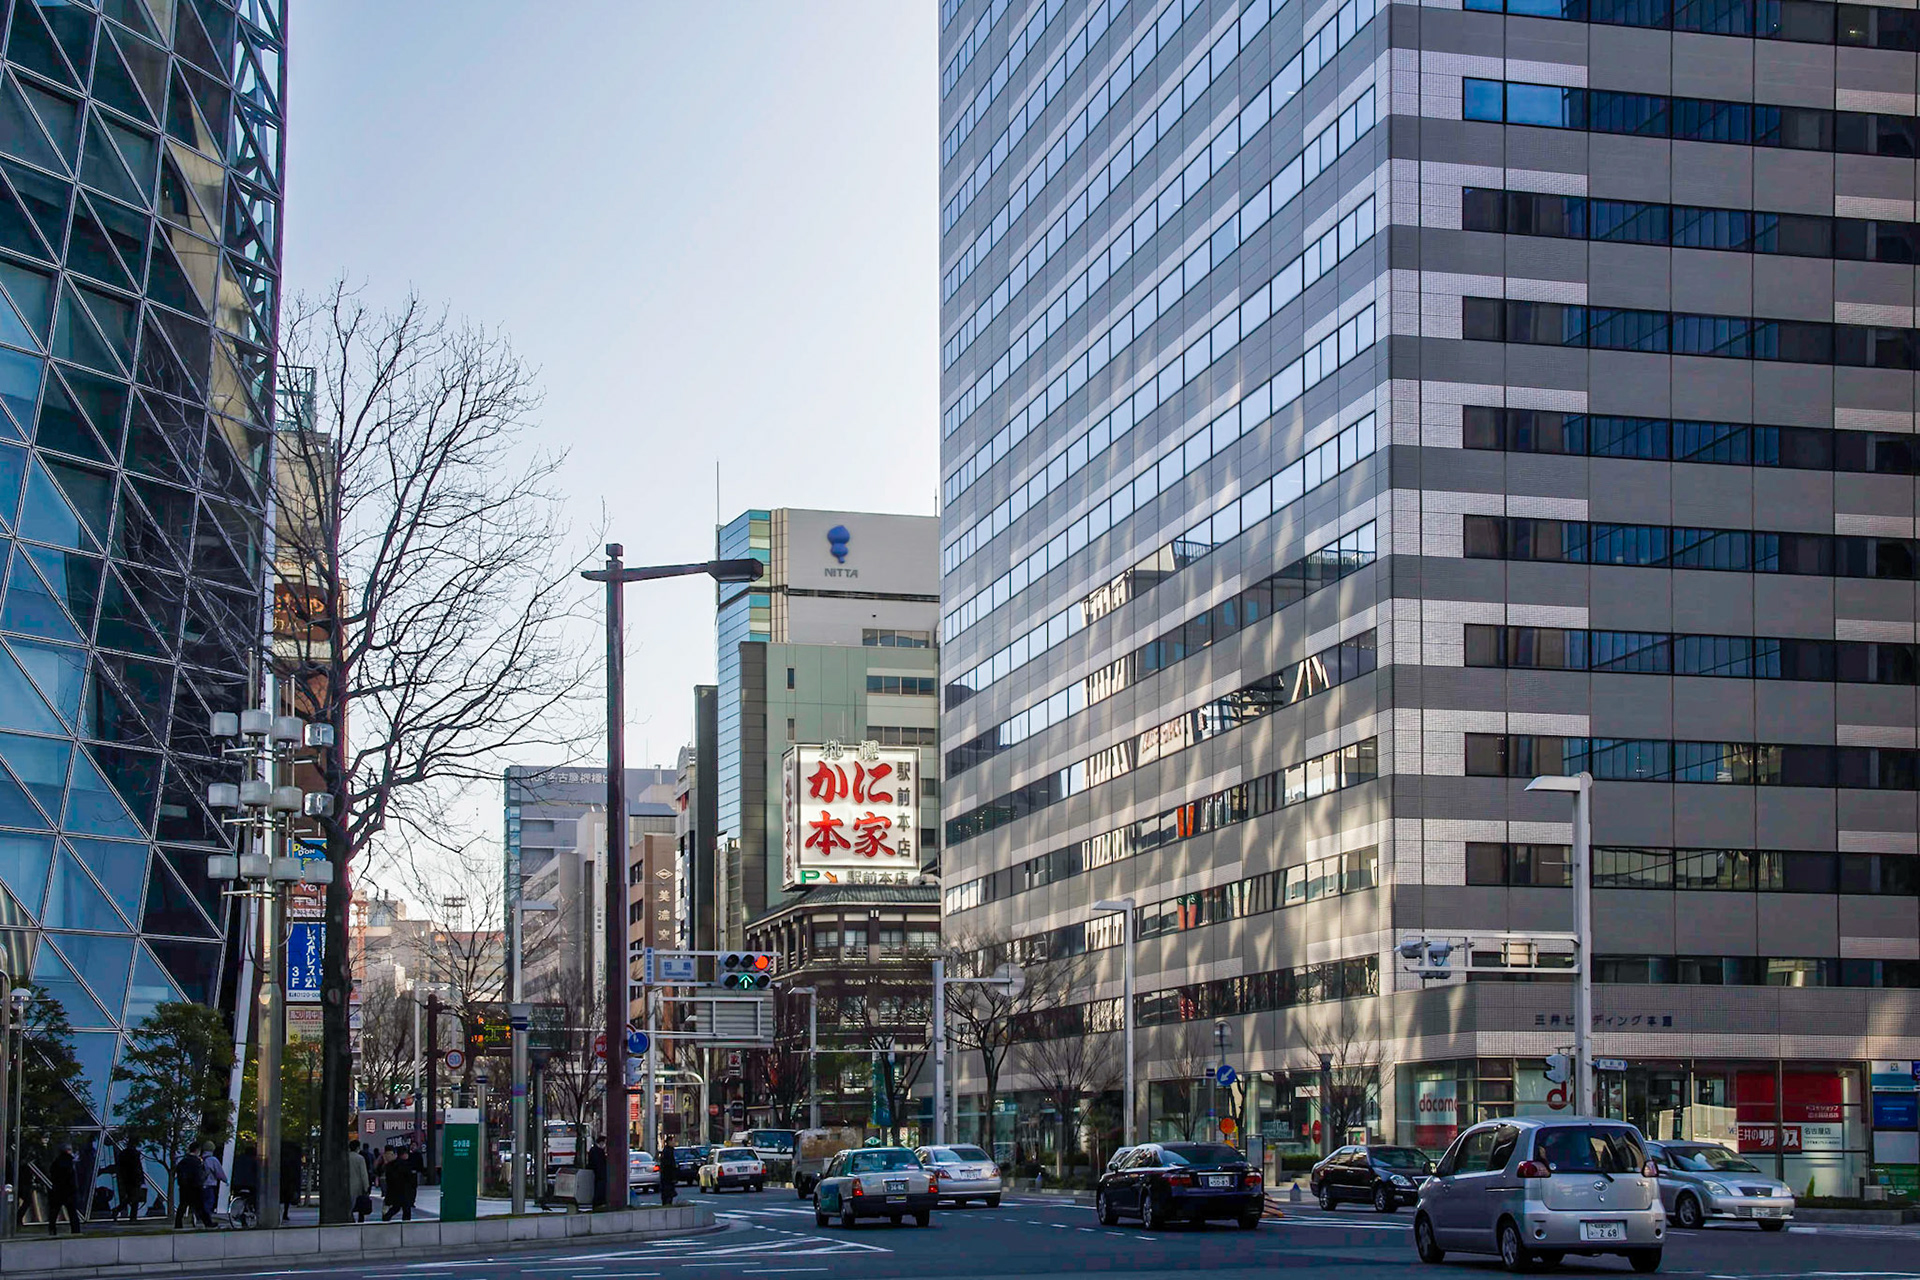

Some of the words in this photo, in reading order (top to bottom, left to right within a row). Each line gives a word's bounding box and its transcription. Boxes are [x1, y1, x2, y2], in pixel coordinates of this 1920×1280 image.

[825, 568, 858, 578] NITTA
[806, 760, 893, 804] かに
[897, 761, 911, 858] 駅前本店
[805, 810, 896, 858] 本家
[846, 870, 910, 885] 駅前本店
[1535, 1014, 1672, 1027] 三井ビディング本館
